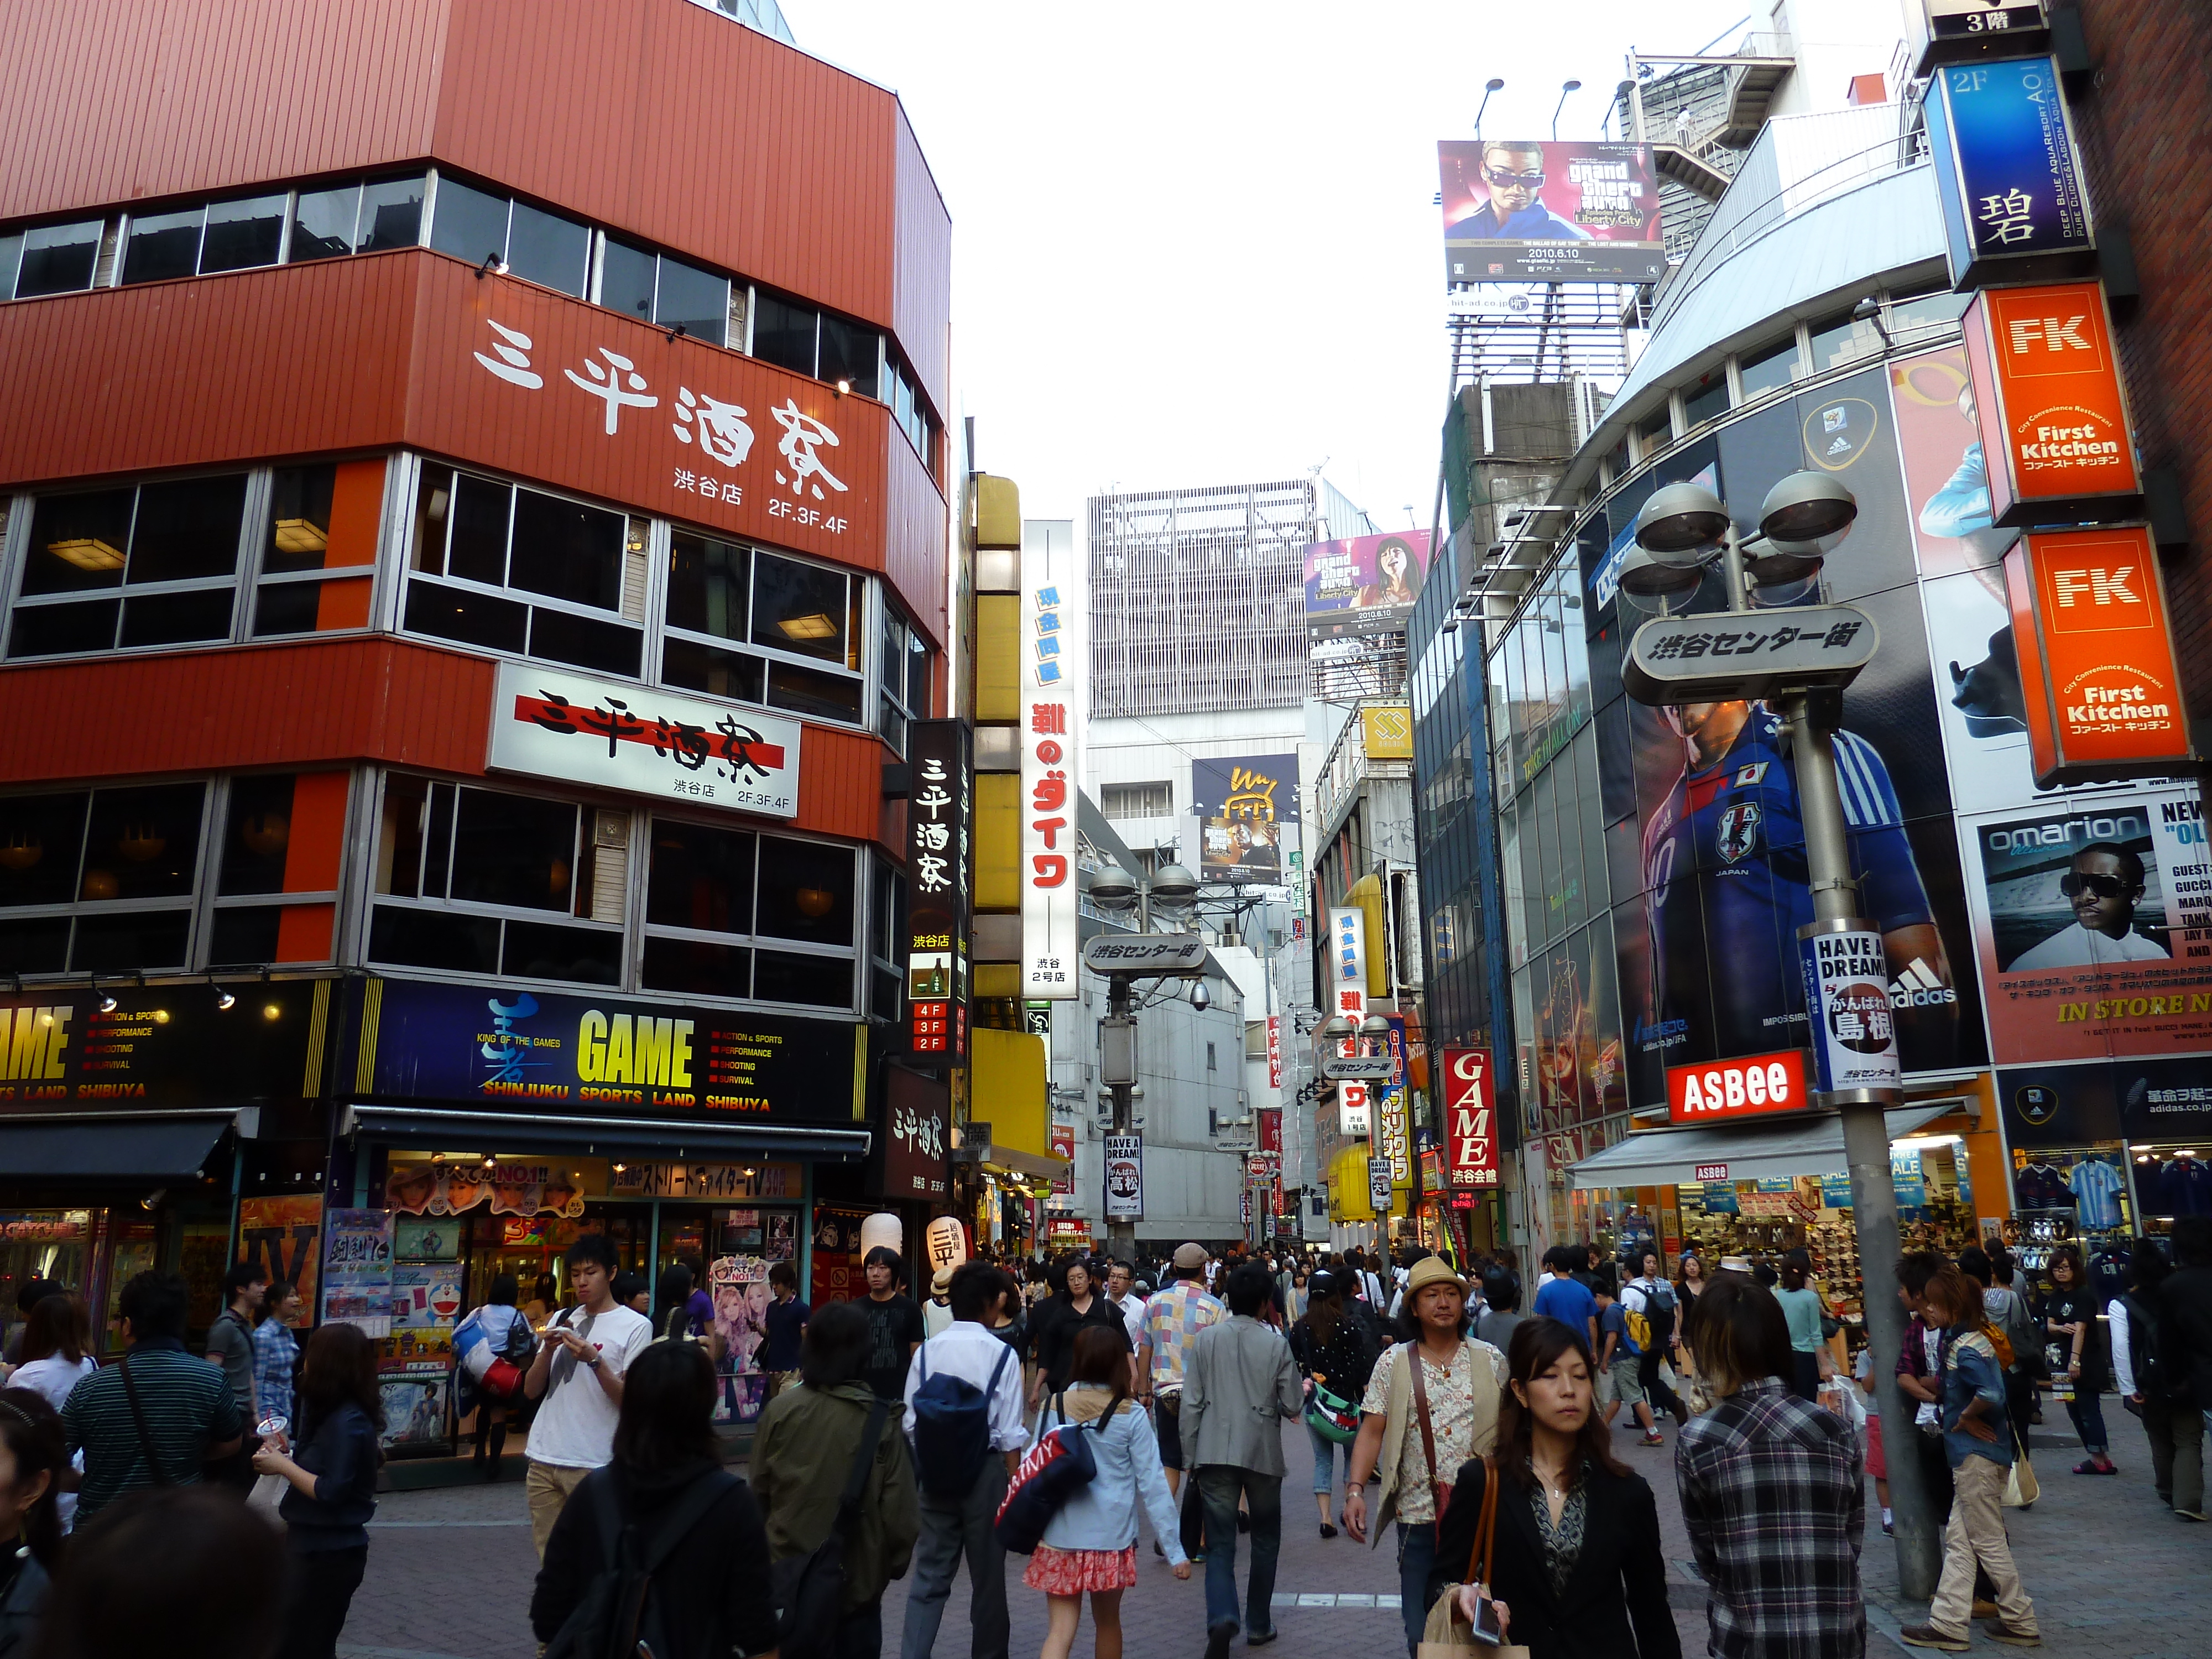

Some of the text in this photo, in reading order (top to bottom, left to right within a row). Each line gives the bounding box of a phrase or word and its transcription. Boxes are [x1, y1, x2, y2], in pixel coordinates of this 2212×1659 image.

[1968, 12, 2009, 32] 3階
[1953, 70, 1989, 93] 2F
[2053, 97, 2062, 124] AQUA
[2021, 65, 2073, 238] DEEP BLUE AQUARESORT AOI
[1582, 181, 1643, 198] theft
[1575, 215, 1641, 228] Liberty City
[1978, 188, 2035, 245] 碧
[2075, 210, 2085, 238] PURE
[1528, 249, 1579, 258] 2010.6.10
[1452, 299, 1508, 308] hit-ad.co.jp
[2008, 316, 2092, 354] FK
[2017, 405, 2113, 434] City Convenience Restaurant
[2037, 424, 2095, 442] First
[1827, 444, 1851, 456] adidas
[2021, 440, 2117, 460] Kitchen
[674, 468, 848, 535] 渋谷店 2F.3F.4F
[1316, 591, 1342, 600] Liberty
[1343, 589, 1359, 598] City
[2054, 566, 2141, 607] FK
[1358, 609, 1391, 619] 2010.6.10
[1648, 622, 1861, 660] 渋谷センター街
[2064, 665, 2163, 694] City Convenience Restaurant
[2084, 685, 2146, 704] First
[2067, 702, 2169, 723] Kitchen
[2070, 721, 2171, 734] ファースト キッチン
[674, 779, 789, 810] 渋谷店 2F.3F.4F
[1032, 703, 1067, 888] 靴のダイワ
[916, 759, 952, 892] 三平酒寮
[1989, 815, 2141, 851] omarion
[2175, 879, 2212, 893] GUCCI
[913, 935, 949, 948] 渋谷店
[2184, 929, 2205, 942] JAY
[1092, 943, 1198, 958] 渋谷センター街
[1819, 937, 1871, 959] HAVE
[2187, 945, 2210, 957] AND
[1037, 958, 1060, 968] 渋谷
[1032, 972, 1065, 983] 2号店
[921, 1005, 940, 1015] 4F
[2057, 995, 2184, 1022] IN STORE
[920, 1022, 940, 1032] 3F
[1835, 1012, 1891, 1041] 島根
[477, 1033, 561, 1048] KING OF THE GAMES
[722, 1032, 747, 1041] ACTION
[755, 1035, 782, 1044] SPORTS
[920, 1039, 940, 1048] 2F
[577, 1009, 694, 1089] GAME
[721, 1046, 771, 1057] PERFORMANCE
[1389, 1029, 1403, 1085] GAME
[720, 1061, 755, 1071] SHOOTING
[1327, 1062, 1390, 1072] 渋谷センター街
[1844, 1069, 1896, 1078] 渋谷センター街
[719, 1076, 754, 1085] SURVIVAL
[1684, 1062, 1787, 1113] ASBee
[24, 1086, 67, 1100] LAND
[77, 1083, 146, 1098] SHIBUYA
[483, 1081, 770, 1113] SHINJUKU SPORTS LAND SHIBUYA
[2147, 1088, 2212, 1103] 革命ヲ起コ
[1453, 1052, 1489, 1166] GAME
[893, 1107, 942, 1161] 三平酒寮
[1390, 1087, 1408, 1181] プリクラ
[1107, 1139, 1139, 1148] HAVE A
[1108, 1149, 1139, 1159] DREAM!
[1452, 1169, 1497, 1183] 渋谷会館
[1697, 1167, 1726, 1180] ASBee
[1892, 1160, 1919, 1175] ALE
[913, 1175, 925, 1189] 渋谷店
[1110, 1176, 1138, 1191] 高松
[950, 1223, 961, 1251] 居酒屋
[932, 1228, 954, 1266] 三平
